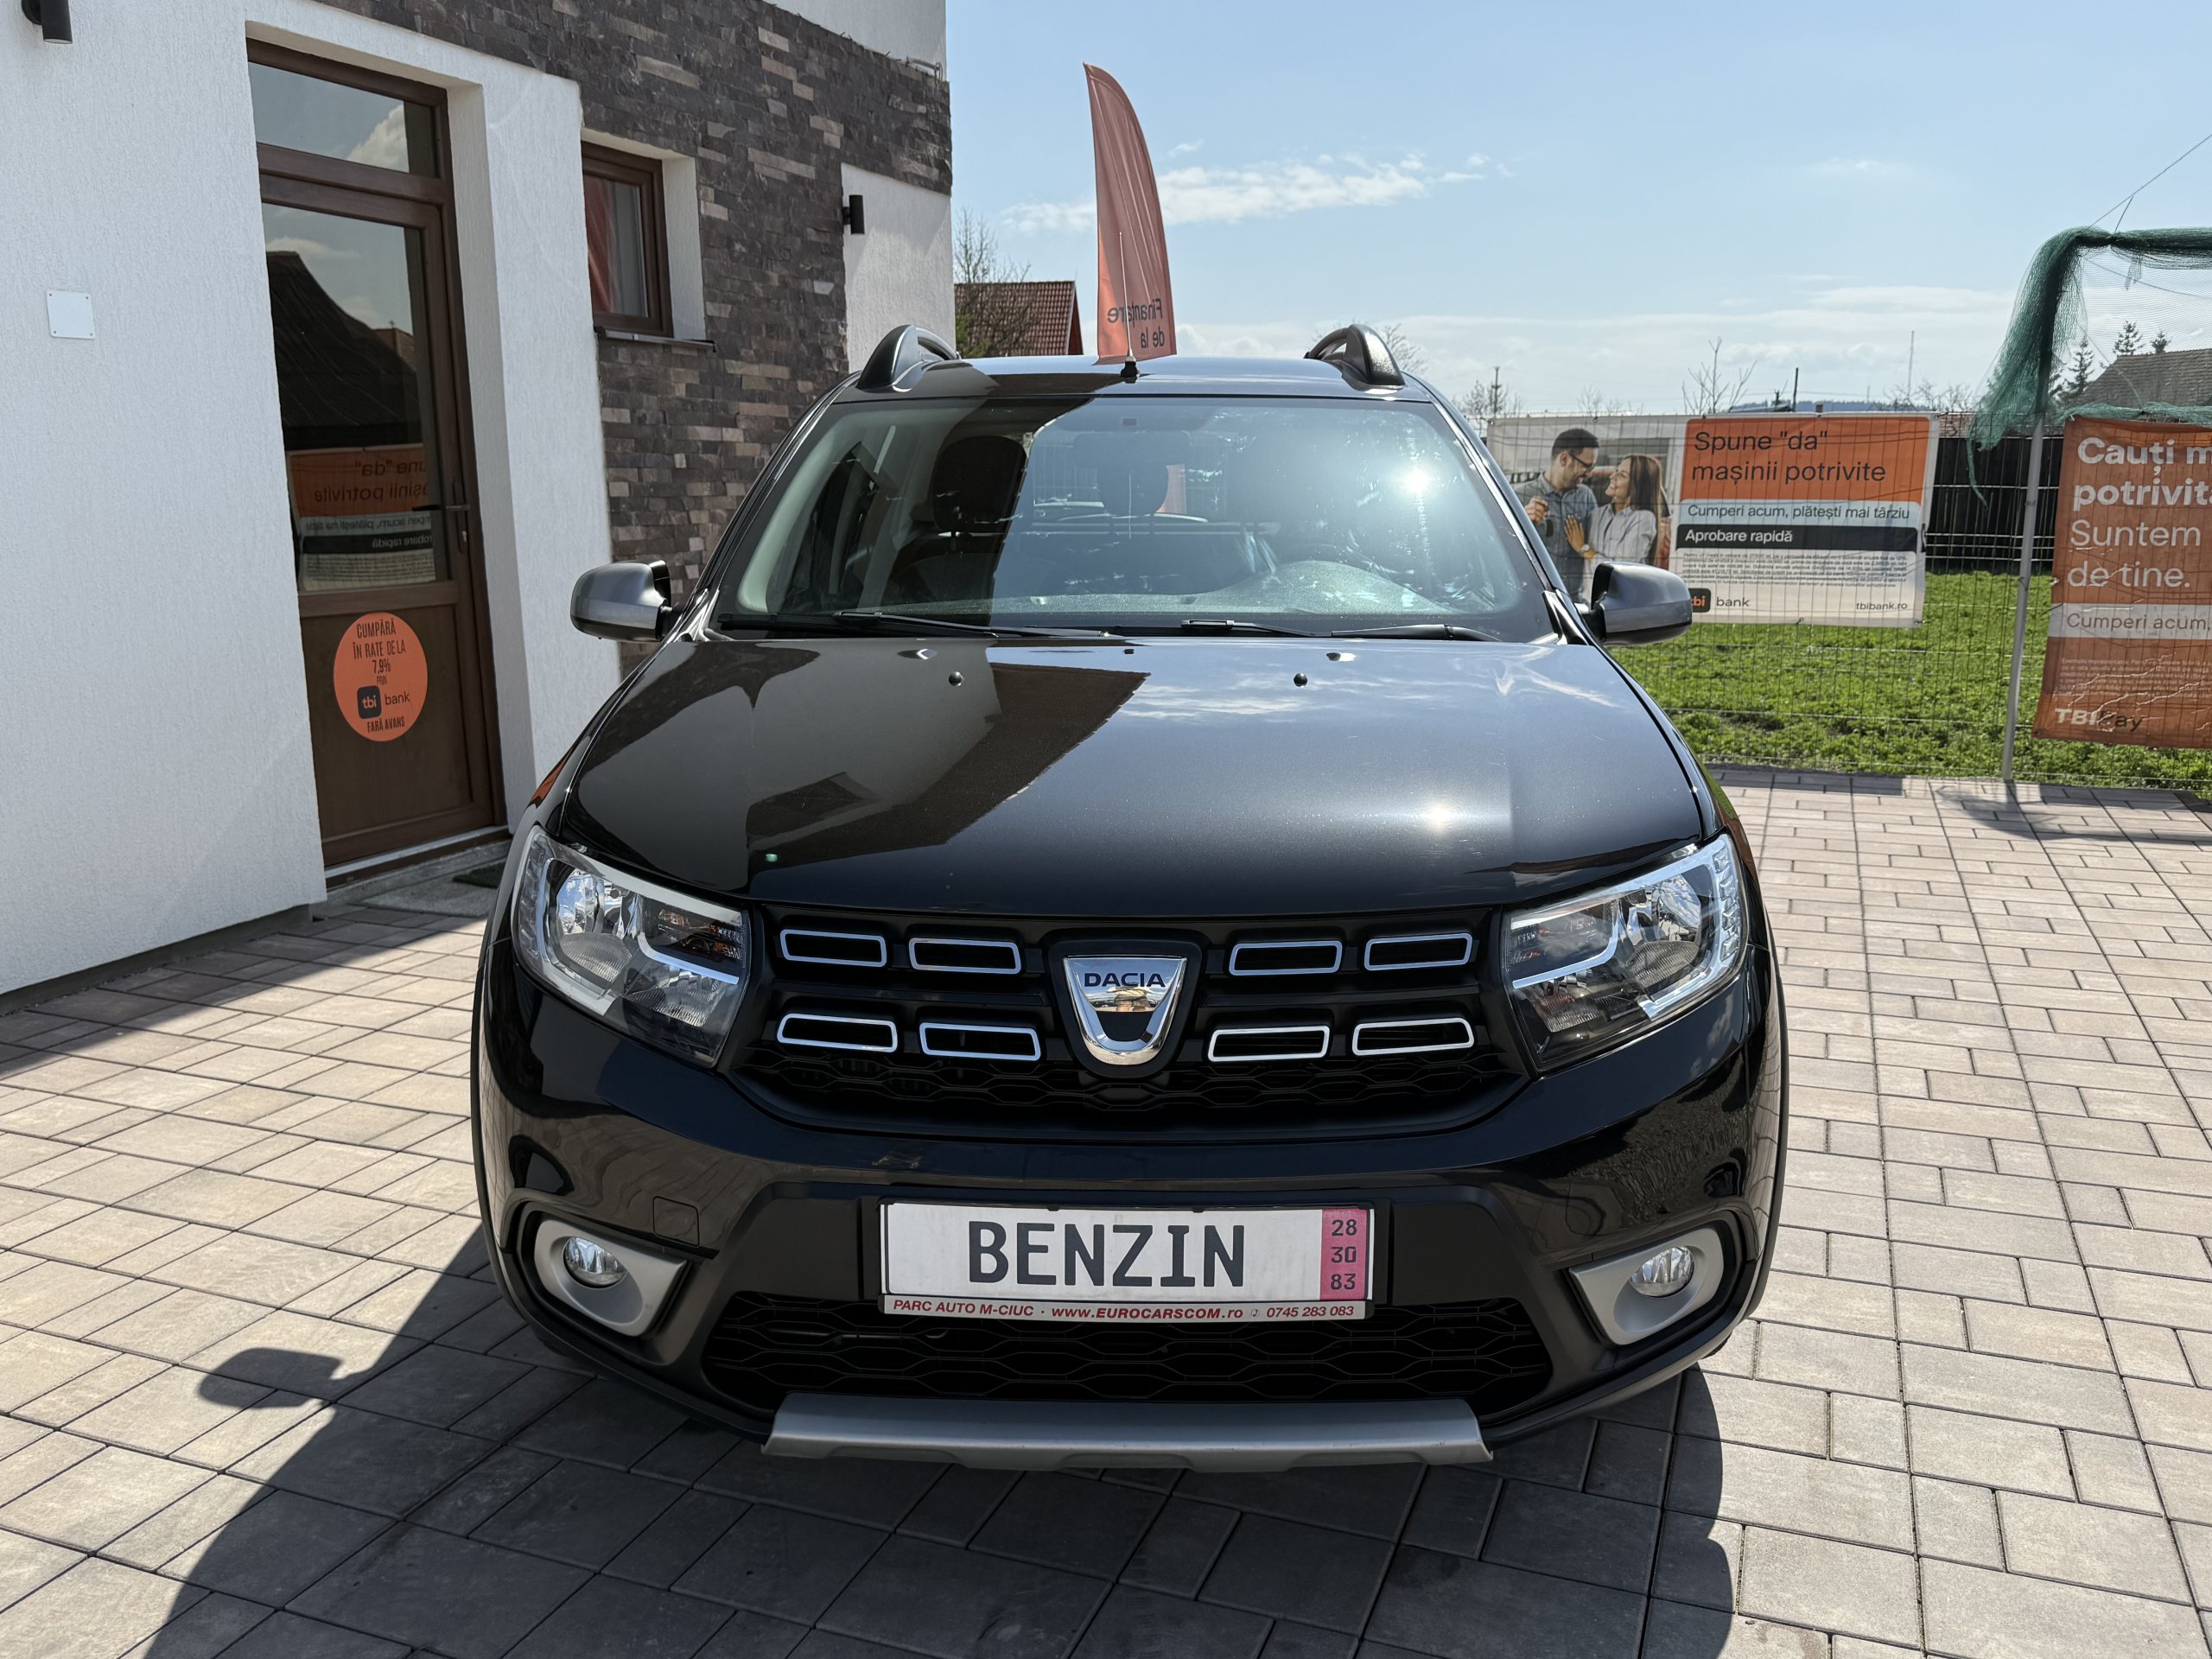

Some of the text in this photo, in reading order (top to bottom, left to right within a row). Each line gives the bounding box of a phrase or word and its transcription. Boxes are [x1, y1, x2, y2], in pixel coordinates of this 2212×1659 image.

[1694, 430, 1828, 454] Spune "da"
[2077, 437, 2176, 476] Cauți
[1692, 461, 1886, 485] mașinii potrivite
[2073, 477, 2212, 512] potrivit
[1688, 504, 1910, 520] Cumperi acum, plătești mai târziu
[1685, 530, 1793, 544] Aprobare rapidă
[2070, 519, 2201, 546] Suntem
[2067, 560, 2190, 588] de tine.
[1716, 596, 1750, 607] bank
[1856, 601, 1908, 611] tbibank.ro
[357, 618, 397, 639] CUMPĂRĂ
[2067, 613, 2147, 634] Cumperi
[353, 639, 406, 659] ÎN RATE DE LA
[372, 658, 391, 674] 7,9%
[362, 692, 410, 709] tbi bank
[385, 716, 406, 731] AVANS
[1084, 972, 1166, 988] DACIA
[1331, 1218, 1357, 1237] 28
[969, 1220, 1244, 1287] BENZIN
[1330, 1245, 1357, 1264] 30
[1330, 1272, 1357, 1291] 83
[893, 1299, 1355, 1319] PARC AUTO M-CIUC www.EUROCARSCOM.ro 0745 283 083
